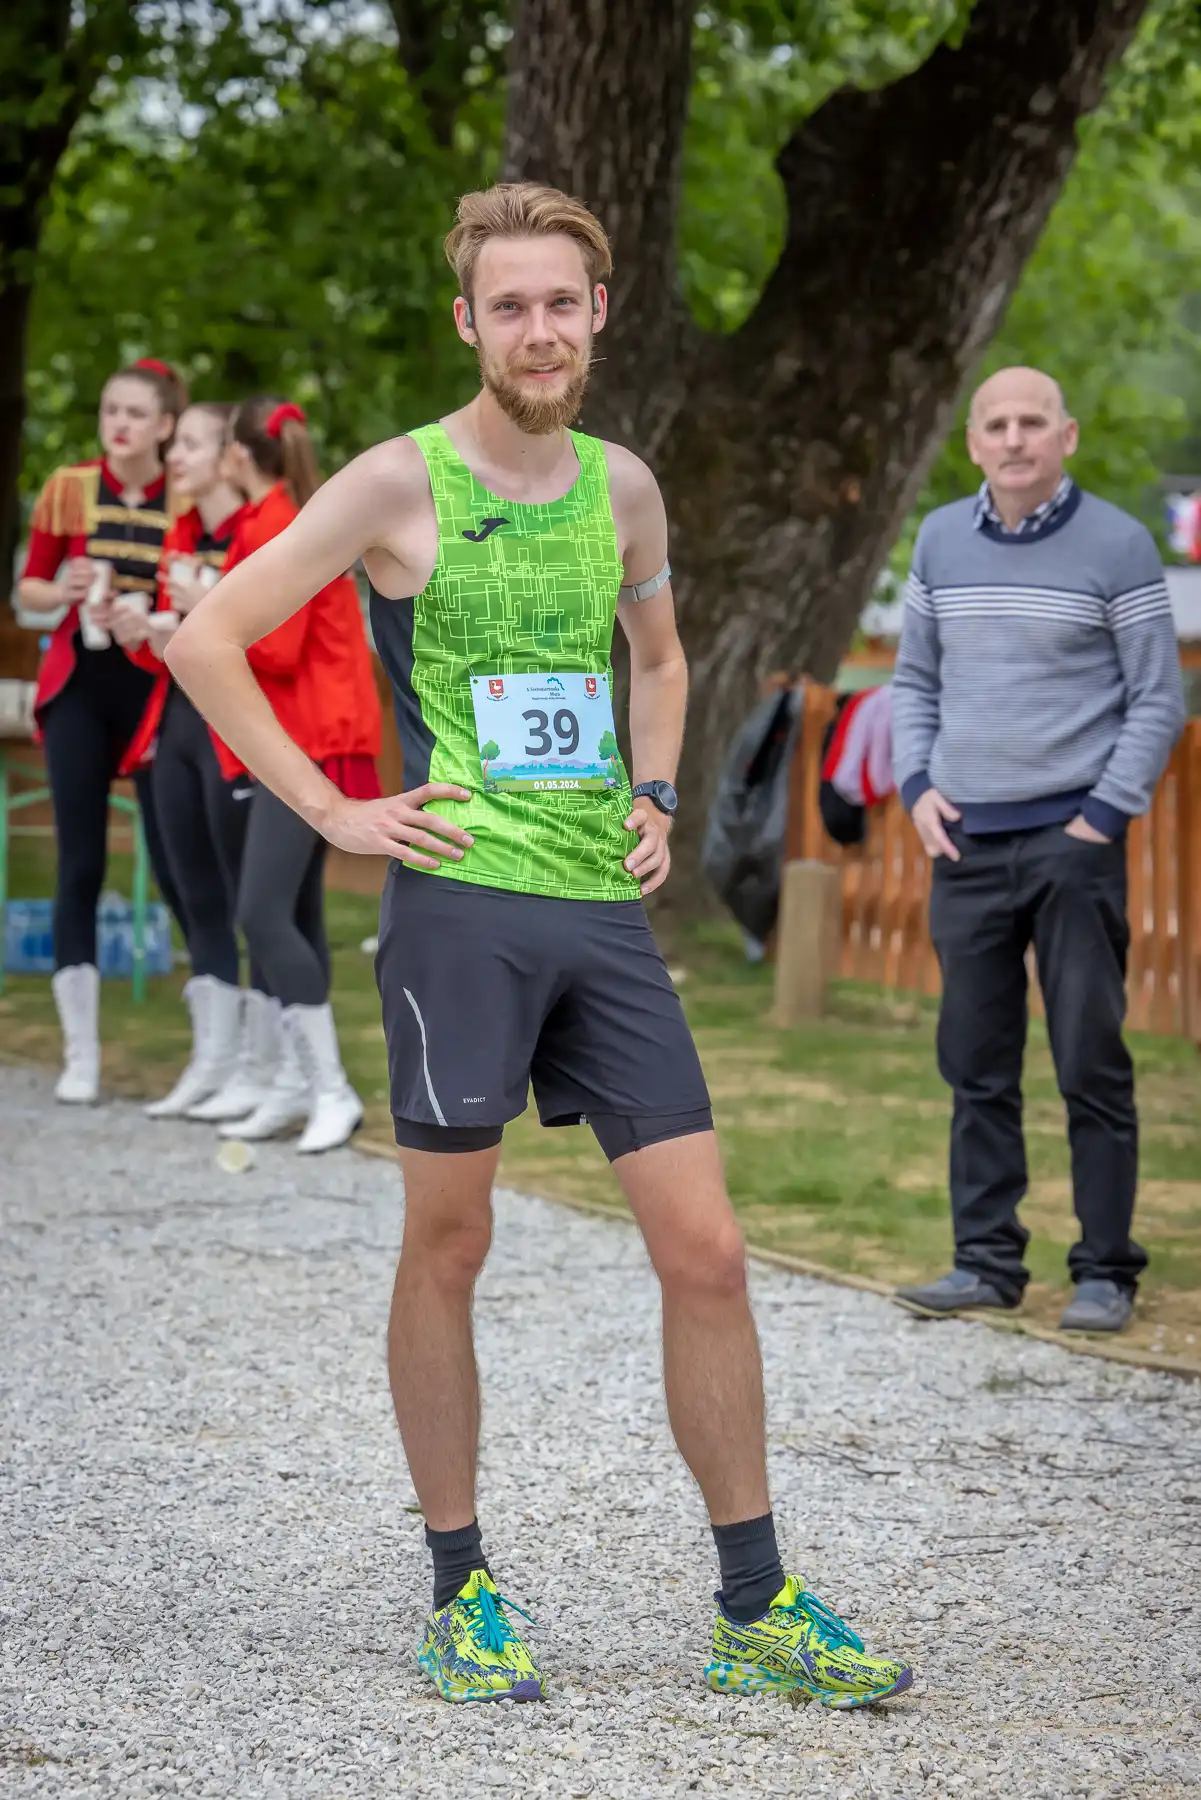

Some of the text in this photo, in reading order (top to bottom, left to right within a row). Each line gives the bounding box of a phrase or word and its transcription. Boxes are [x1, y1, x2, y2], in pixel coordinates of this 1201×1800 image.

[521, 708, 580, 756] 39
[533, 780, 582, 790] 01.05.2024.
[462, 1096, 486, 1104] EVADICT
